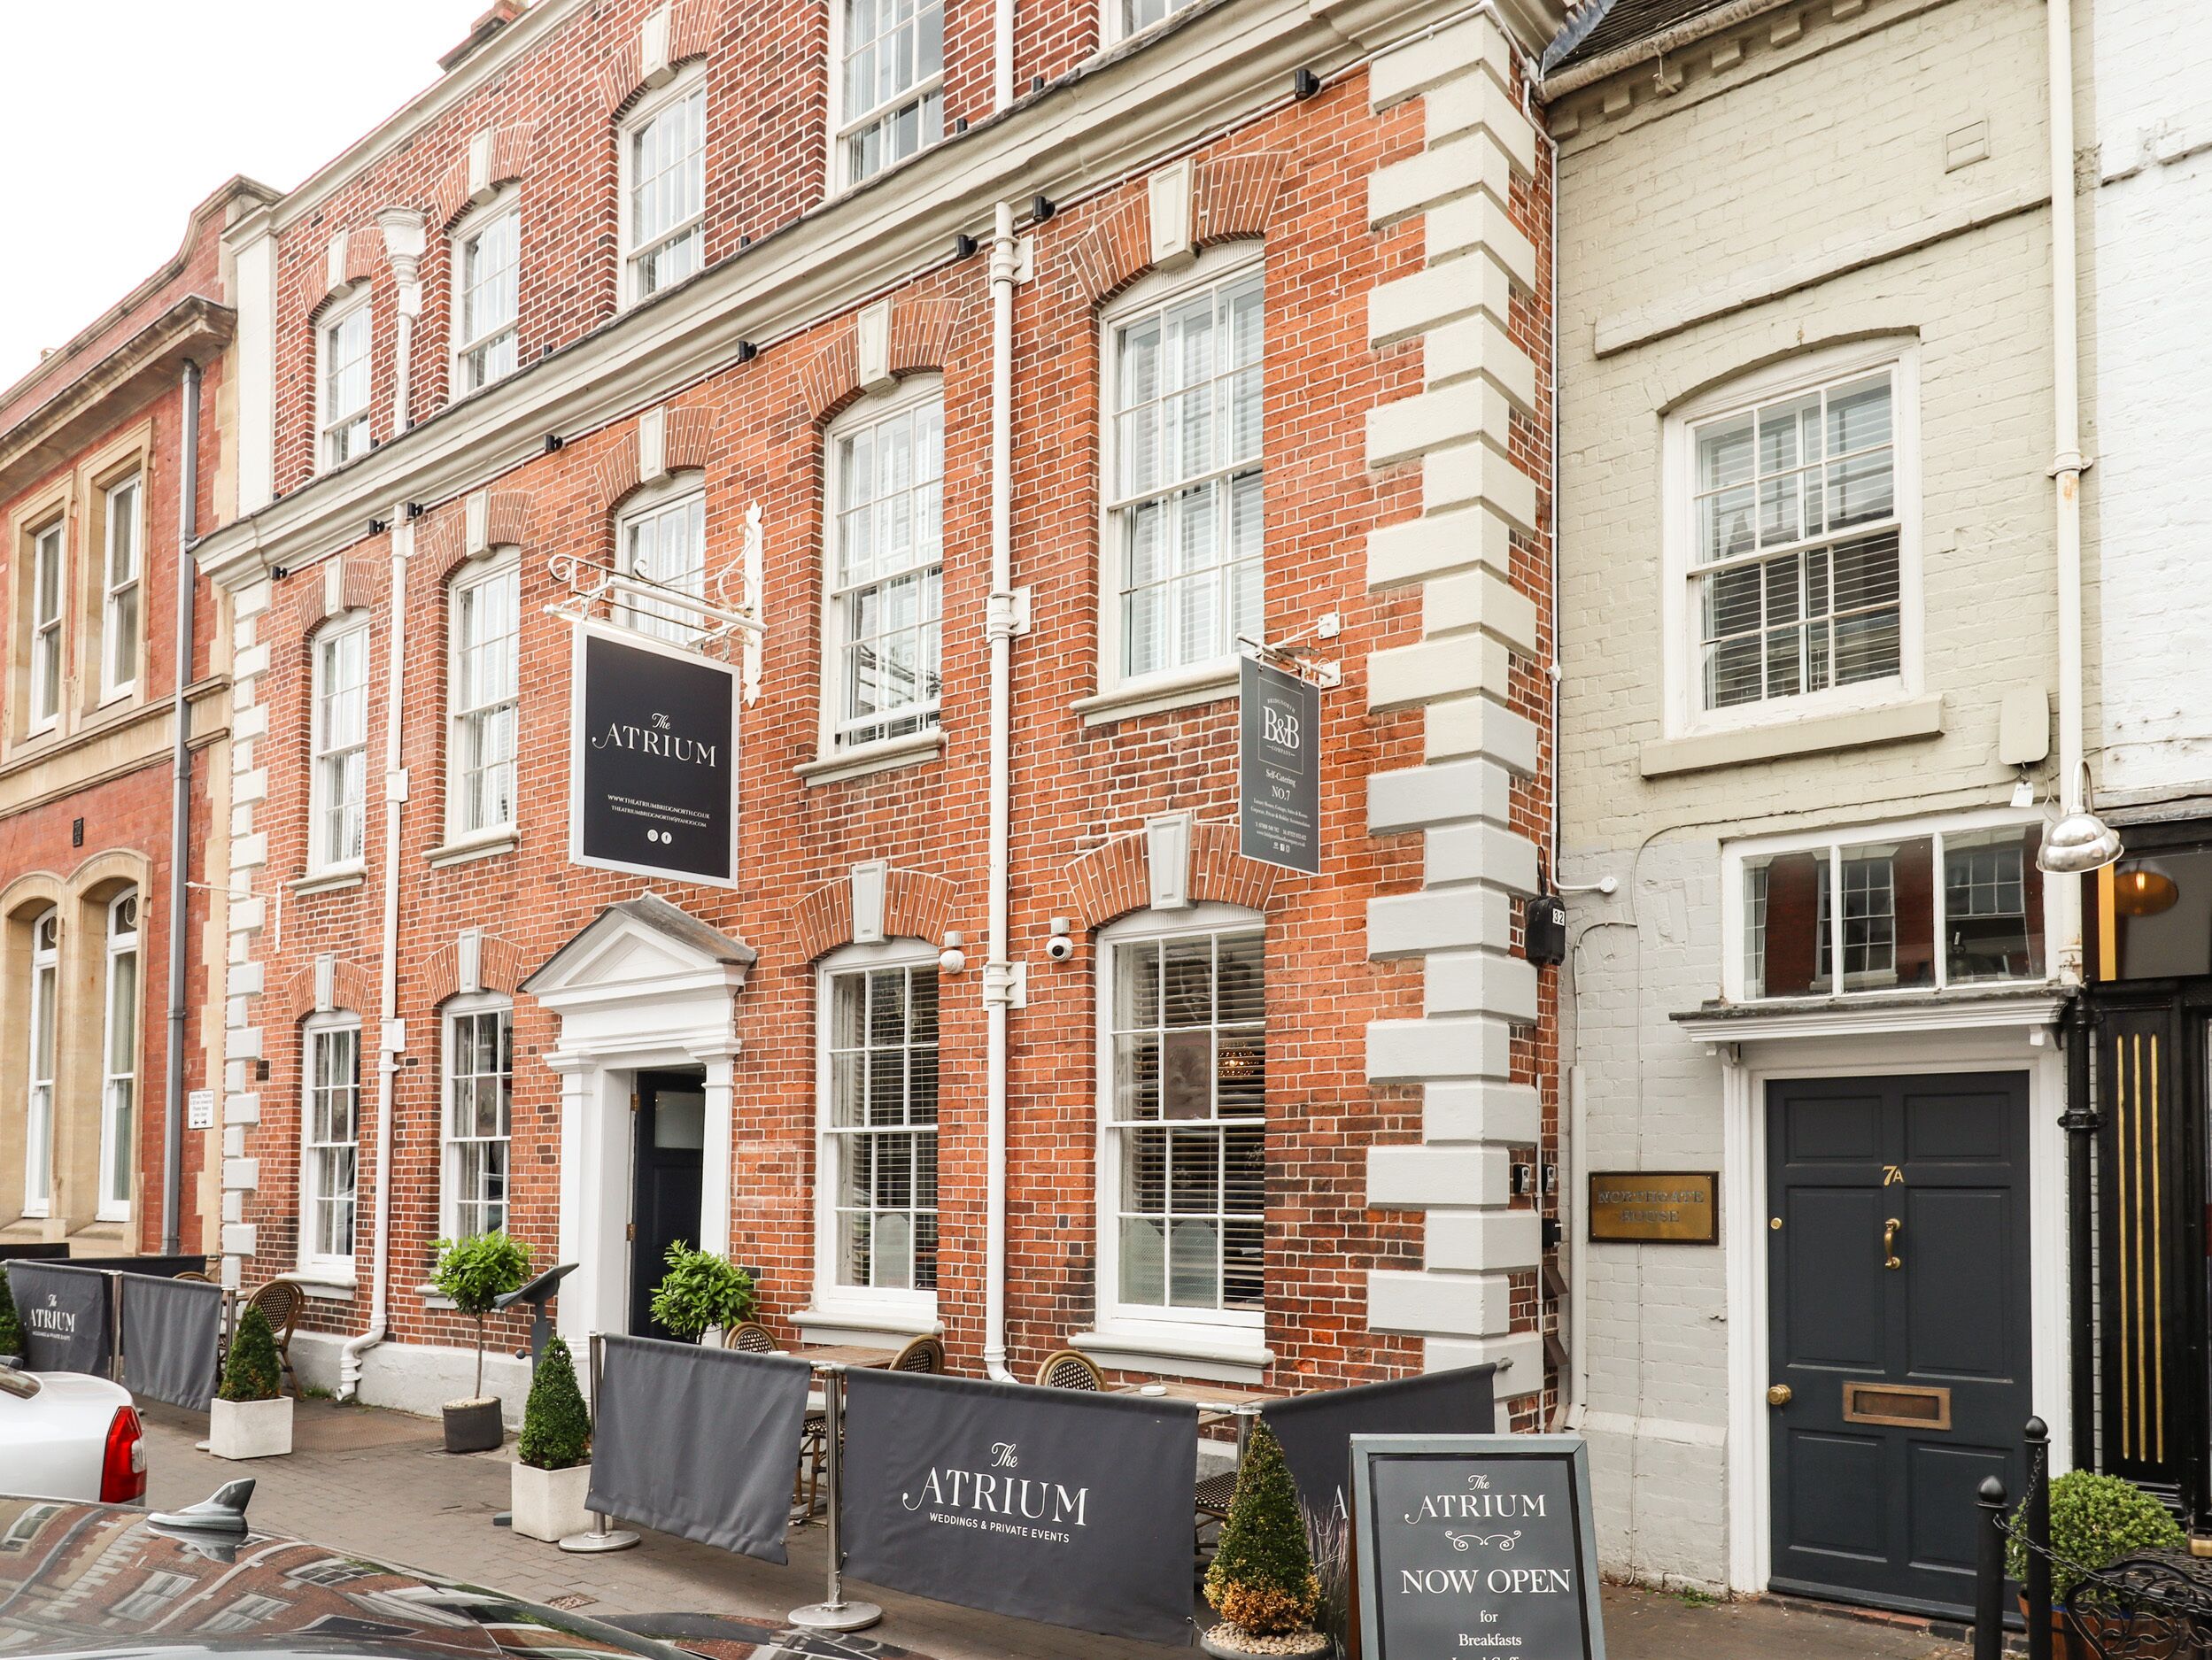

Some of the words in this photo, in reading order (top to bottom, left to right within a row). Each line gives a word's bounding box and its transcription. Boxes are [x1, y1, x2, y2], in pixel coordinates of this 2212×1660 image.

[651, 712, 671, 730] The
[1262, 706, 1300, 749] B&B
[592, 722, 716, 768] ATRIUM
[1265, 768, 1296, 788] Self-Catering
[1554, 911, 1564, 923] 32
[1883, 1165, 1904, 1186] 7A
[1597, 1190, 1705, 1204] NORTHGATE
[1620, 1210, 1679, 1224] HOUSE
[24, 1308, 76, 1332] ATRIUM
[991, 1441, 1018, 1468] The
[1467, 1474, 1490, 1490] The
[901, 1466, 1089, 1526] ATRIUM
[1404, 1494, 1547, 1525] ATRIUM
[930, 1512, 978, 1529] WEDDINGS
[980, 1520, 987, 1530] &
[990, 1522, 1028, 1537] PRIVATE
[1032, 1528, 1070, 1543] EVENTS
[1401, 1570, 1480, 1594] NOW
[1487, 1569, 1571, 1594] OPEN
[1480, 1610, 1498, 1623] for
[1458, 1633, 1522, 1647] Breakfasts
